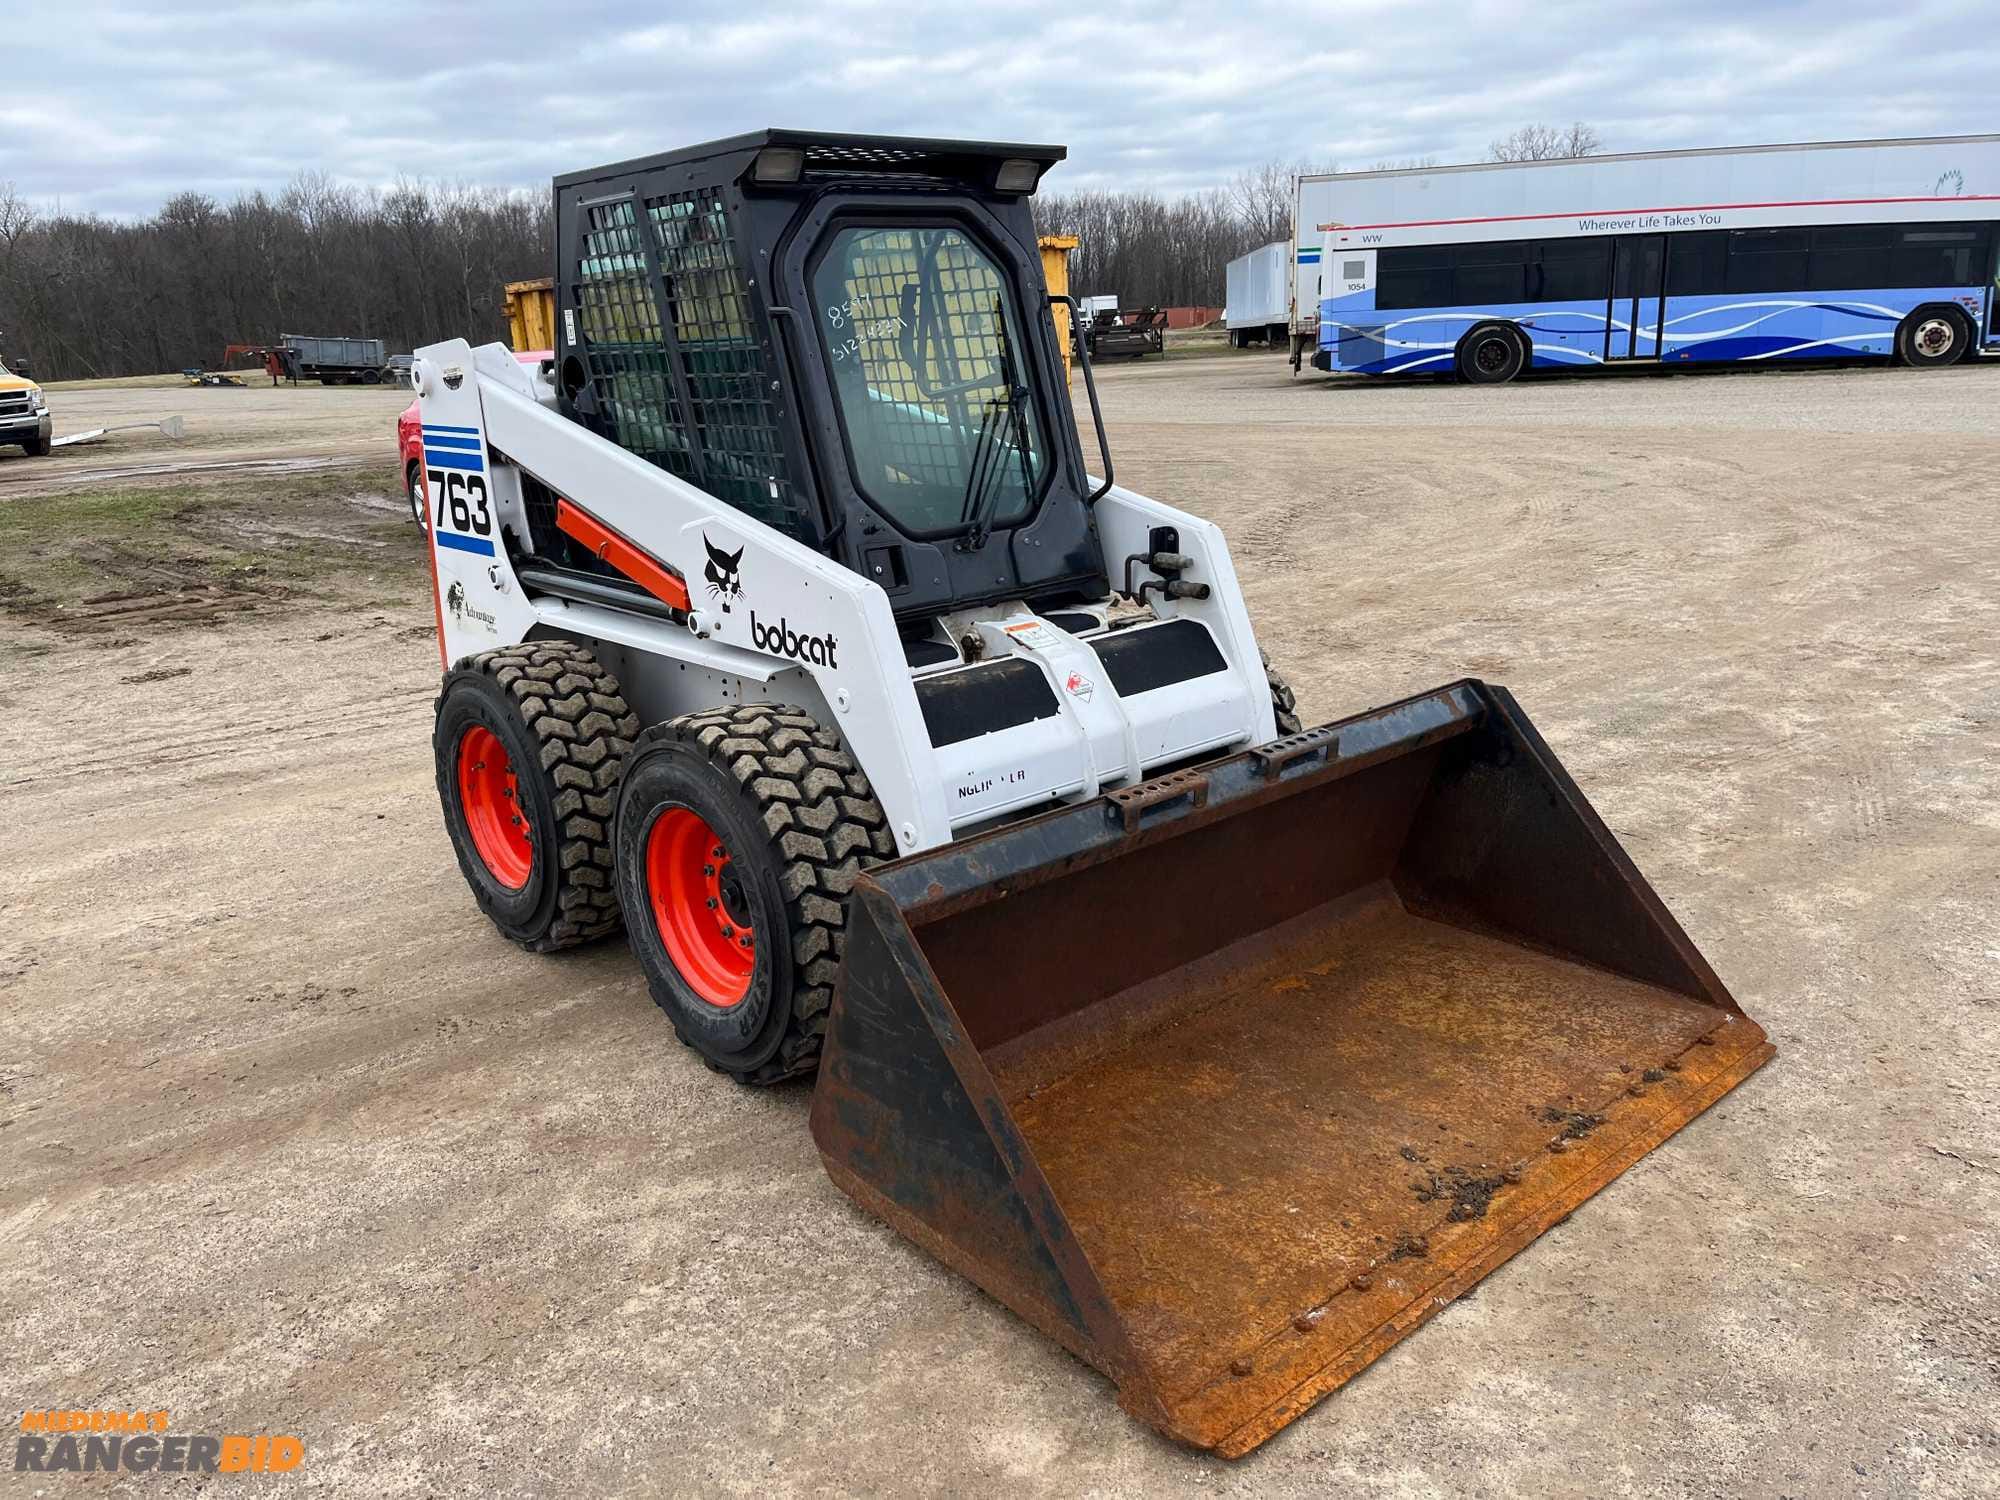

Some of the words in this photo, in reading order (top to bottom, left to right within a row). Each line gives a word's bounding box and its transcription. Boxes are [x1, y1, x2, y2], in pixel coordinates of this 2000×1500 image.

[1579, 219, 1636, 231] Wherever
[1639, 216, 1660, 228] Life
[1663, 214, 1696, 227] Takes
[1699, 213, 1721, 225] You
[1347, 283, 1366, 291] 1054
[427, 470, 491, 536] 763
[750, 610, 838, 670] bobcat
